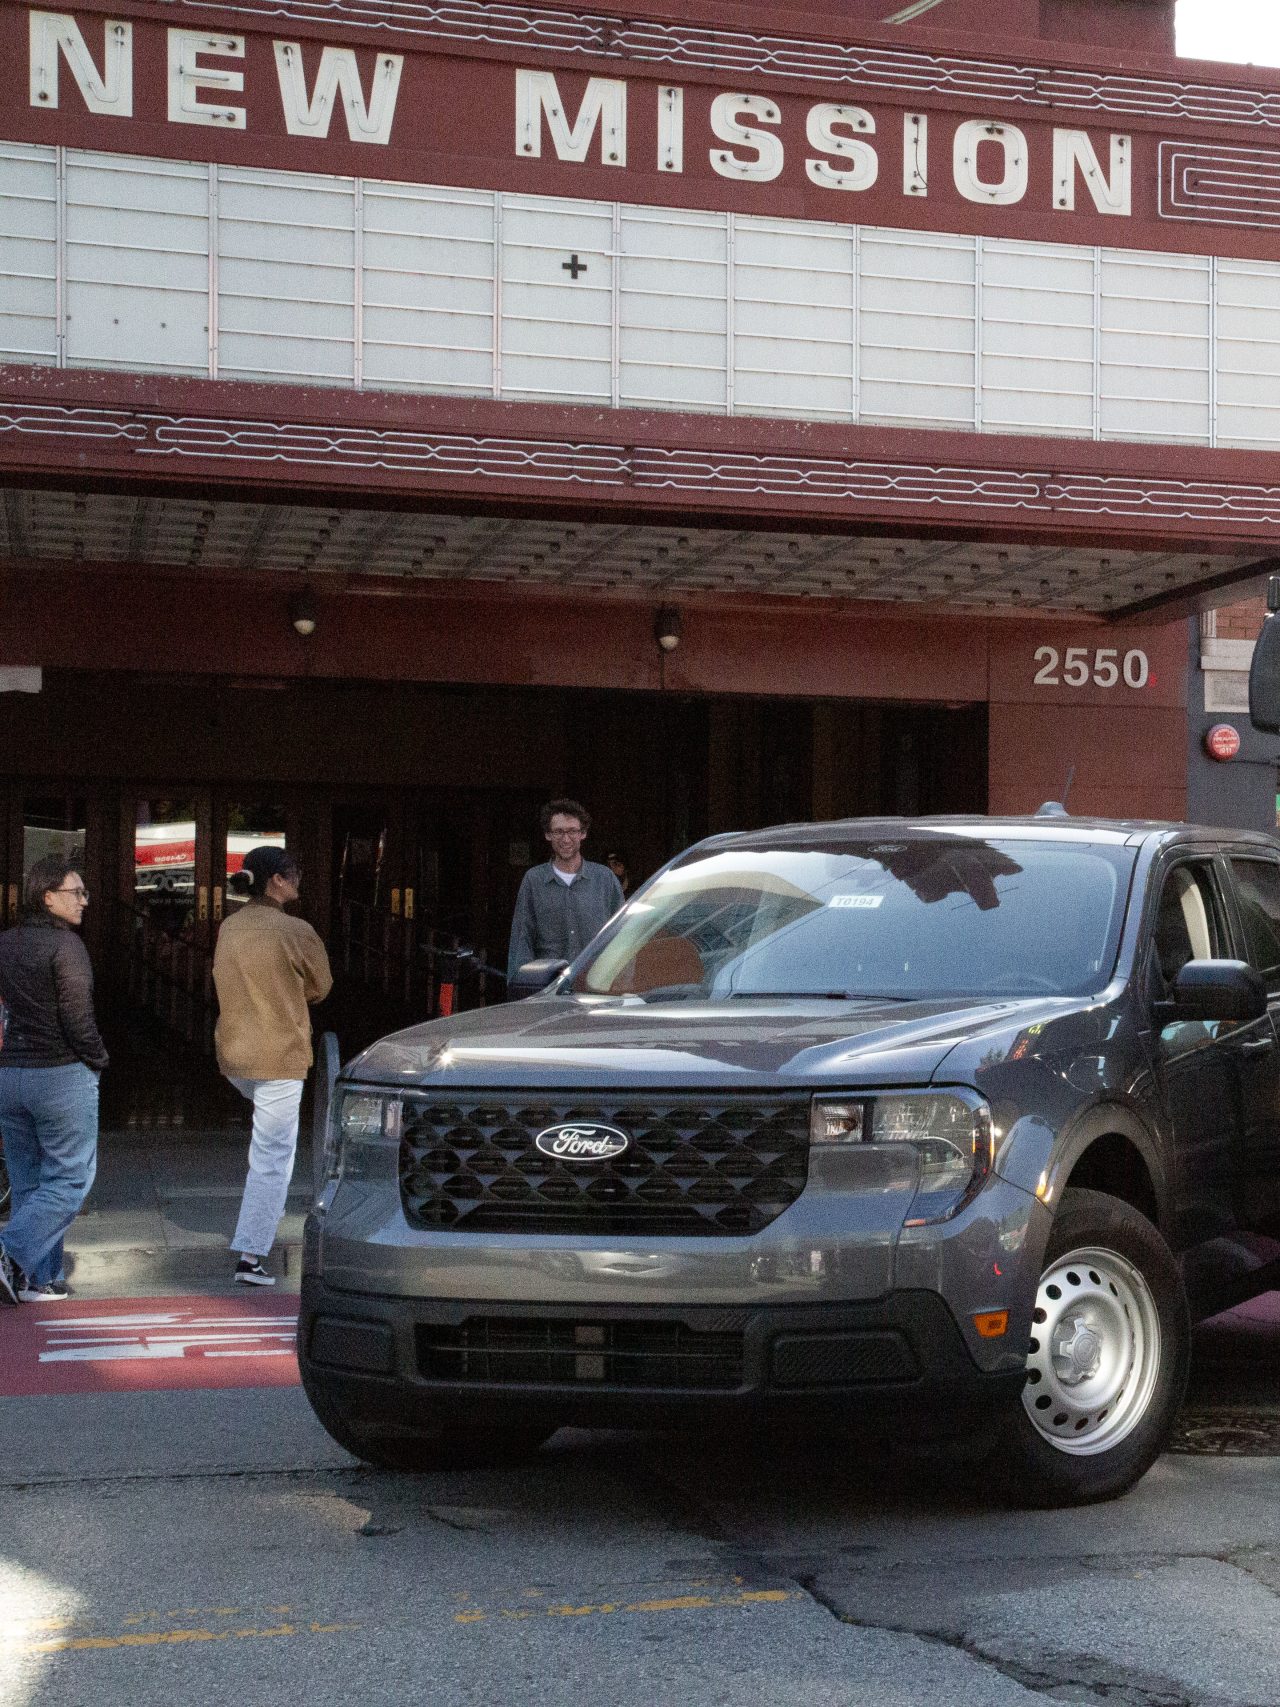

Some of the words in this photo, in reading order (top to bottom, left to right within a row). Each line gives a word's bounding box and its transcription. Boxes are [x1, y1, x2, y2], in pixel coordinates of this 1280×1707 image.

[29, 10, 404, 146] NEW
[515, 69, 1132, 216] MISSION
[1033, 645, 1149, 688] 2550
[835, 897, 874, 906] T0194
[553, 1125, 609, 1156] Ford
